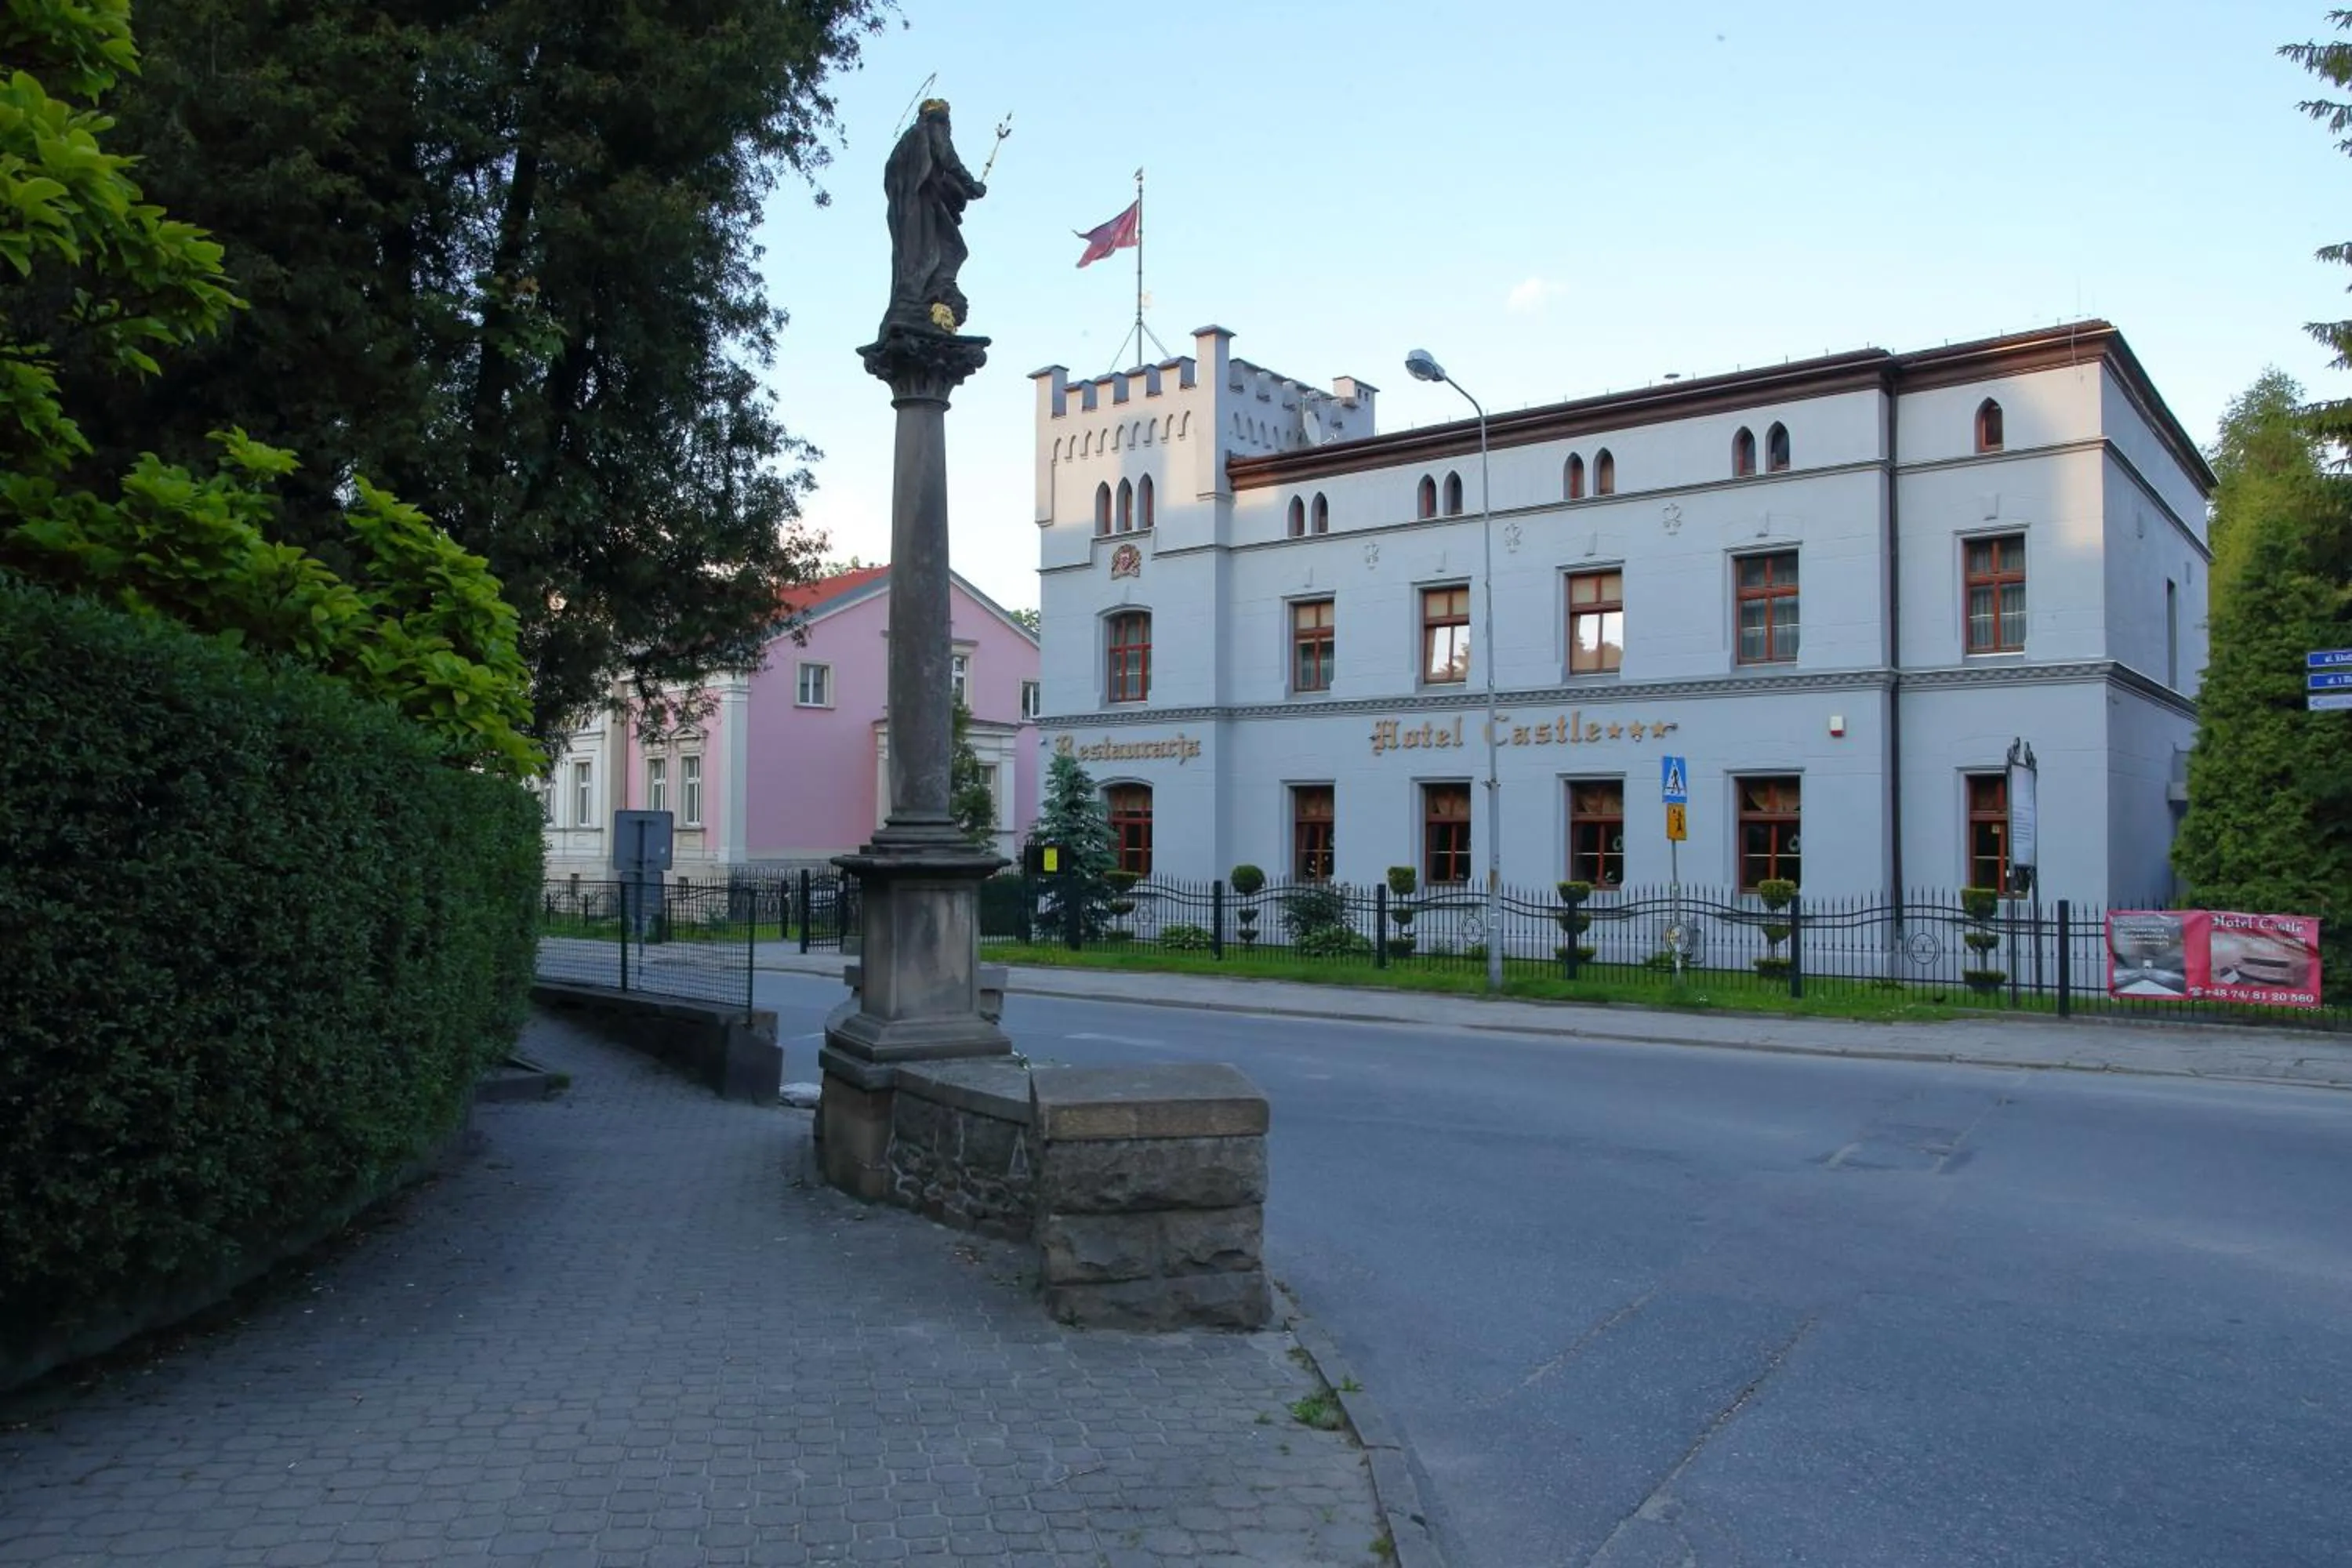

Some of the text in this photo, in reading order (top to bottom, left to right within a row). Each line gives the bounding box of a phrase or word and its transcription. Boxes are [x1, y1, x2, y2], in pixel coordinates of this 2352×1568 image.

[1369, 710, 1602, 756] Hotel Castle
[2212, 915, 2252, 929] Hotel
